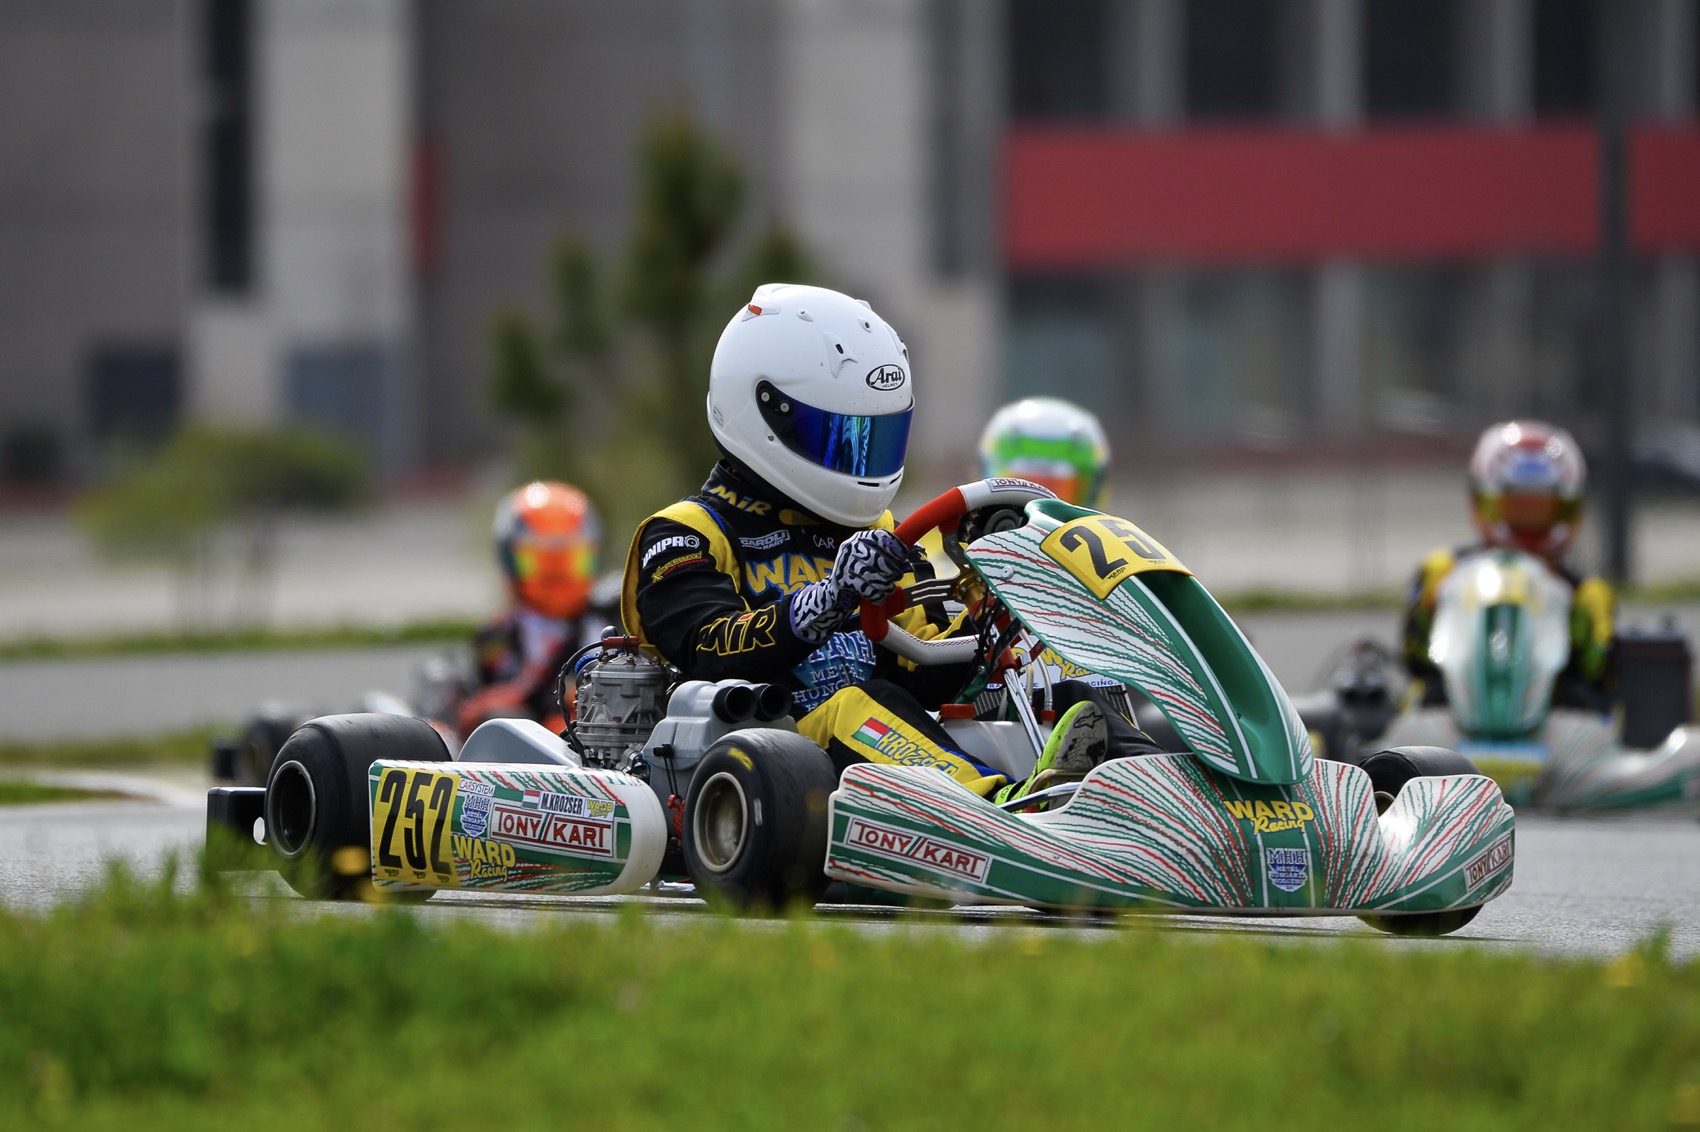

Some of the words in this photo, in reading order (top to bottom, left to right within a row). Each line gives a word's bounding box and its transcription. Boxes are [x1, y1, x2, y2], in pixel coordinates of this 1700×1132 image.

[870, 367, 902, 386] Arai
[1107, 567, 1126, 580] WARD
[460, 779, 495, 796] CARSYSTEM
[464, 794, 490, 812] MHH
[541, 793, 583, 815] M.KROZSER
[587, 800, 614, 812] WARD
[1223, 800, 1314, 821] WARD
[379, 770, 452, 875] 252
[1250, 816, 1305, 835] Racing
[453, 834, 516, 868] WARD
[1266, 848, 1306, 864] MHH
[469, 858, 508, 882] Racing
